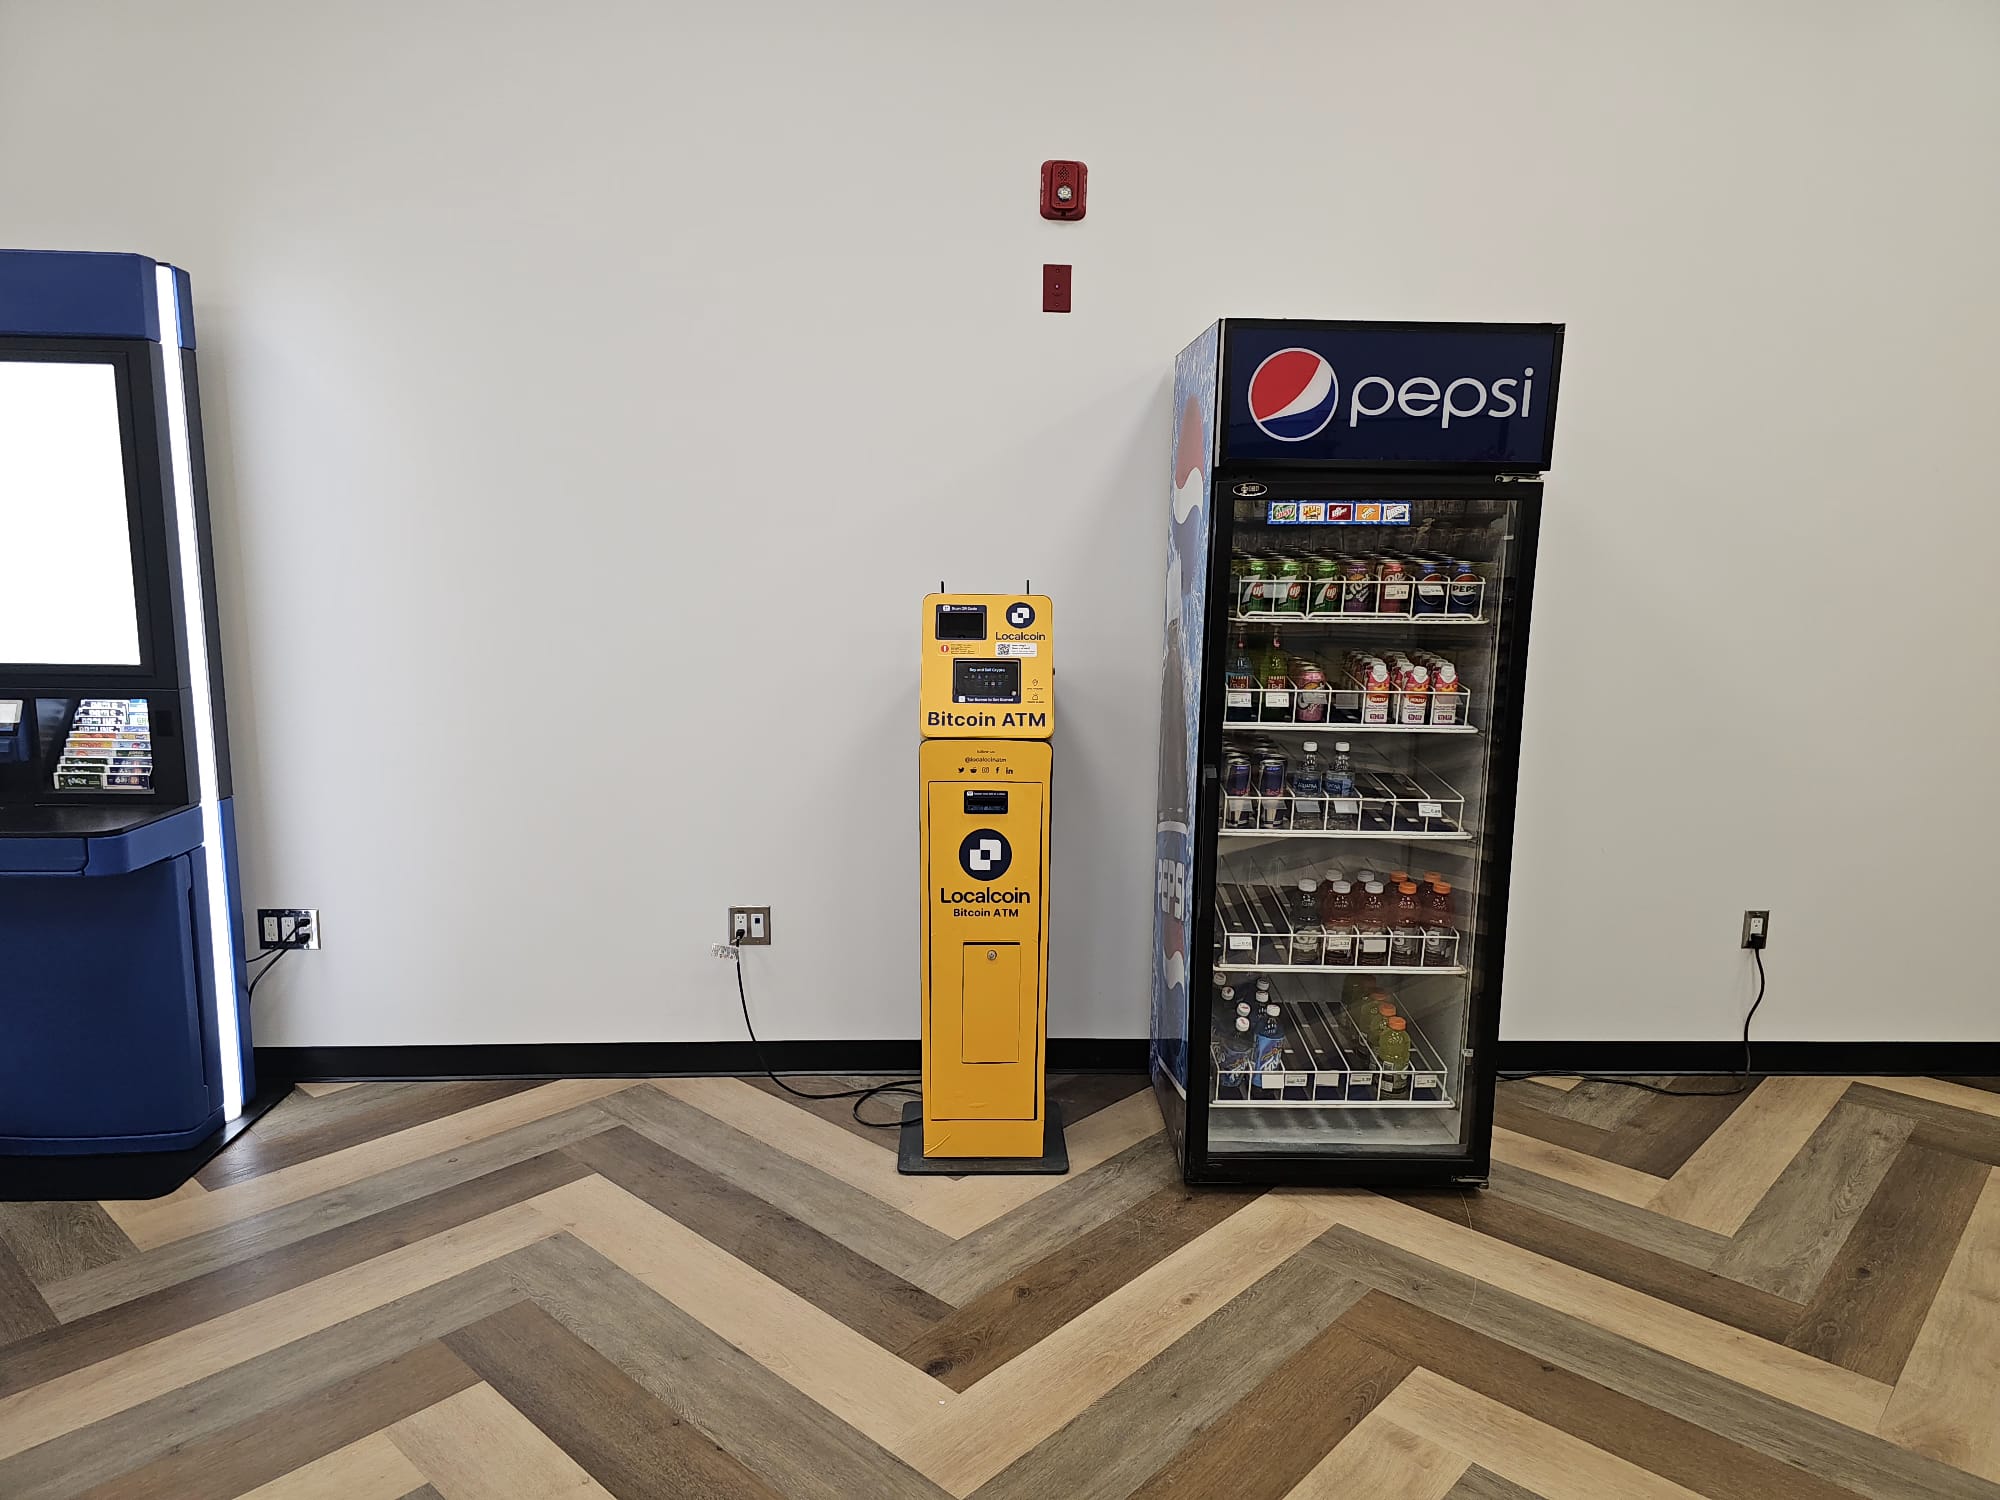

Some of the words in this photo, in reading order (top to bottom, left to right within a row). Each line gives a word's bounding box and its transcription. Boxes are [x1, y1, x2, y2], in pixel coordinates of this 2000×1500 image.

[1349, 367, 1534, 429] pepsi
[995, 631, 1046, 641] Localcoin
[927, 711, 996, 727] Bitcoin
[1001, 712, 1046, 727] ATM
[940, 886, 1031, 904] Localcoin
[953, 908, 991, 917] Bitcoin
[993, 908, 1019, 918] ATM
